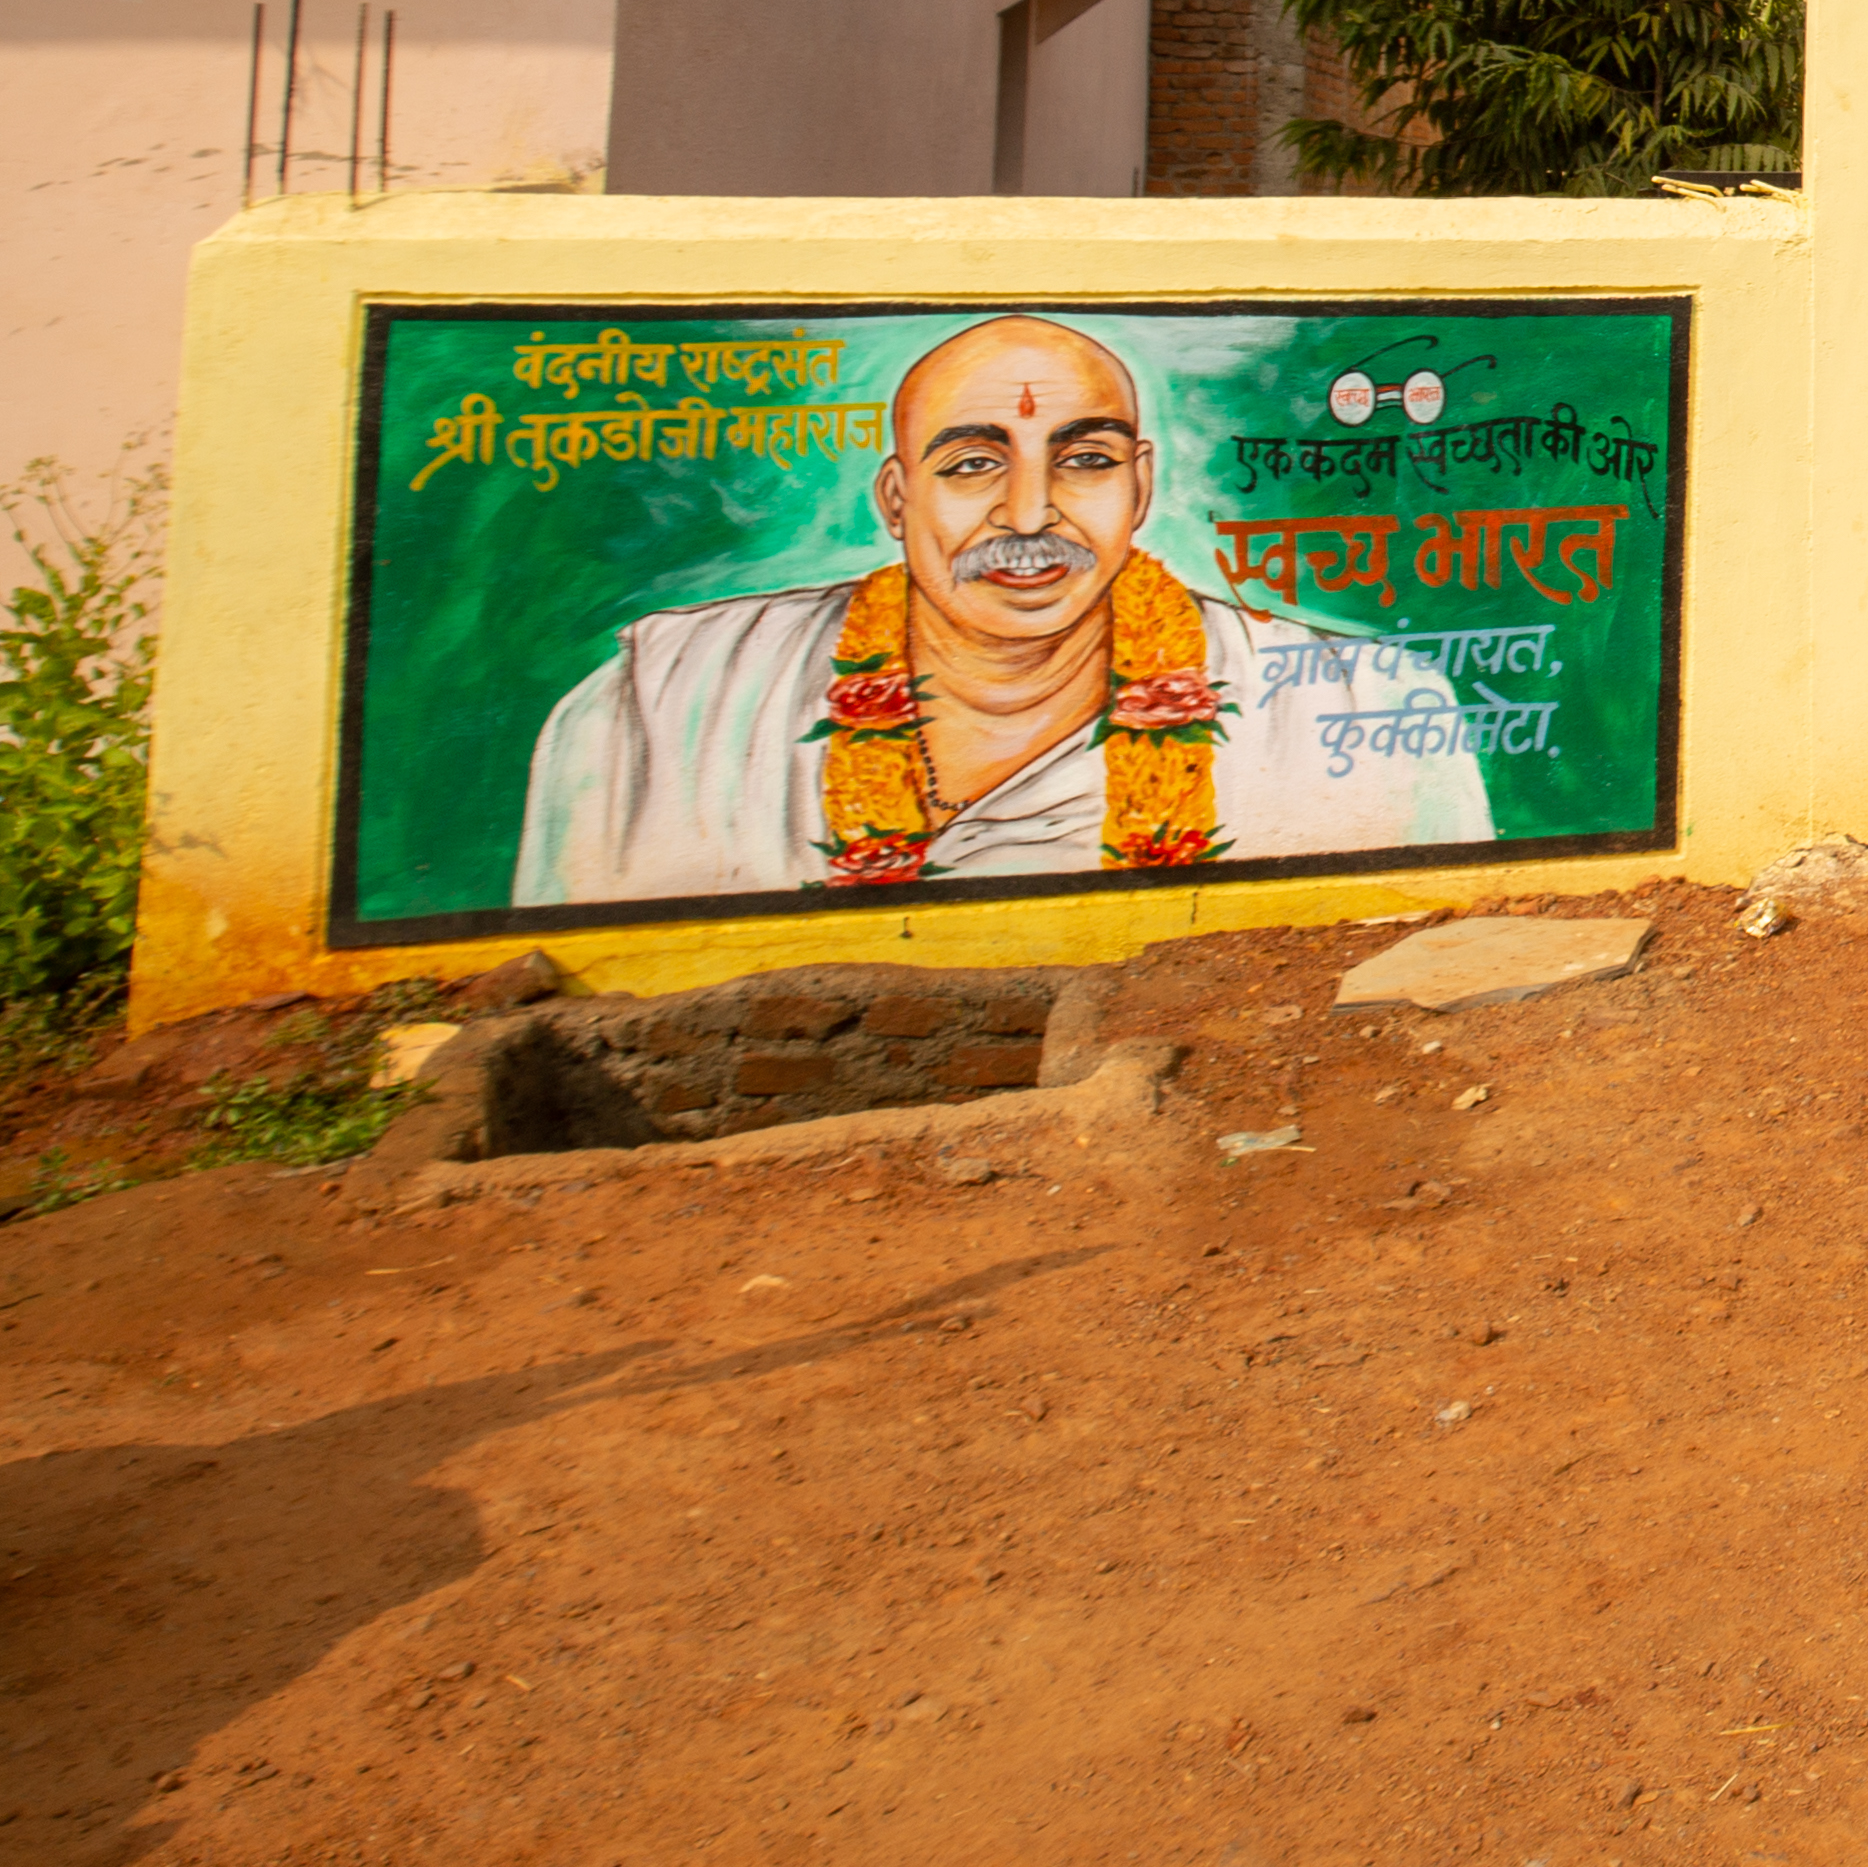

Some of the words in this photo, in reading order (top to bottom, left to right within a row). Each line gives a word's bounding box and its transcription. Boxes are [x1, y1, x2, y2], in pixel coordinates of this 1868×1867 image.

[513, 328, 675, 399] वंदनीय
[680, 328, 844, 394] राष्ट्रसंत
[410, 394, 503, 491] श्री
[506, 391, 729, 491] तुकडोजी
[729, 402, 886, 470] महाराज
[1232, 434, 1294, 493] एक
[1298, 435, 1399, 498] कदम
[1541, 402, 1586, 463] की
[1587, 416, 1660, 519] ओर
[1414, 504, 1629, 605] भारत
[1257, 637, 1373, 708] ग्राम
